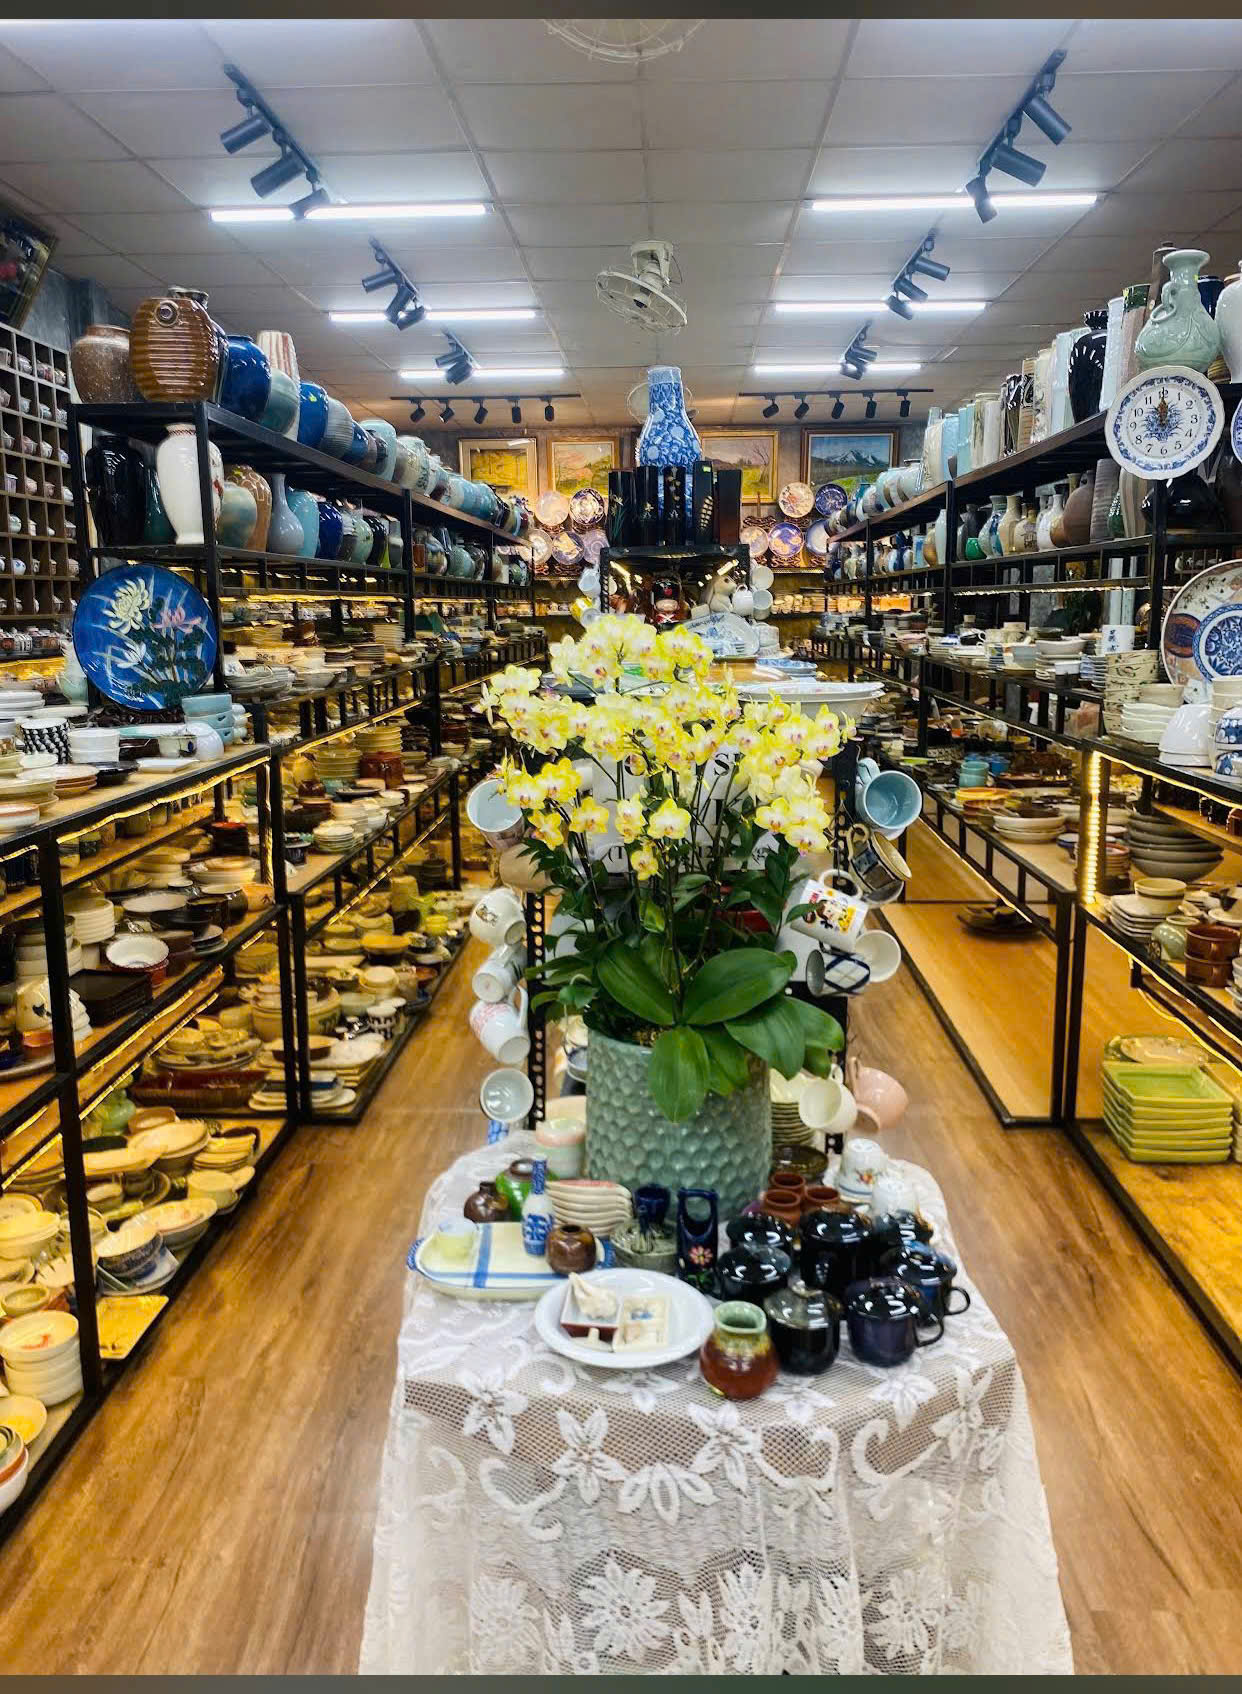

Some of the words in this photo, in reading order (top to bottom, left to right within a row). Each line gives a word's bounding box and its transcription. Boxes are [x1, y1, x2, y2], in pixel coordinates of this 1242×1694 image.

[1158, 389, 1169, 399] 12
[1145, 396, 1152, 405] 11
[1185, 400, 1194, 410] 2
[1134, 408, 1144, 417] 10
[1190, 414, 1198, 424] 3
[1129, 422, 1137, 431] 9
[1185, 428, 1193, 438] 4
[1135, 435, 1143, 445] 8
[1174, 440, 1182, 450] 5
[1145, 443, 1154, 453] 7
[1160, 446, 1168, 455] 6
